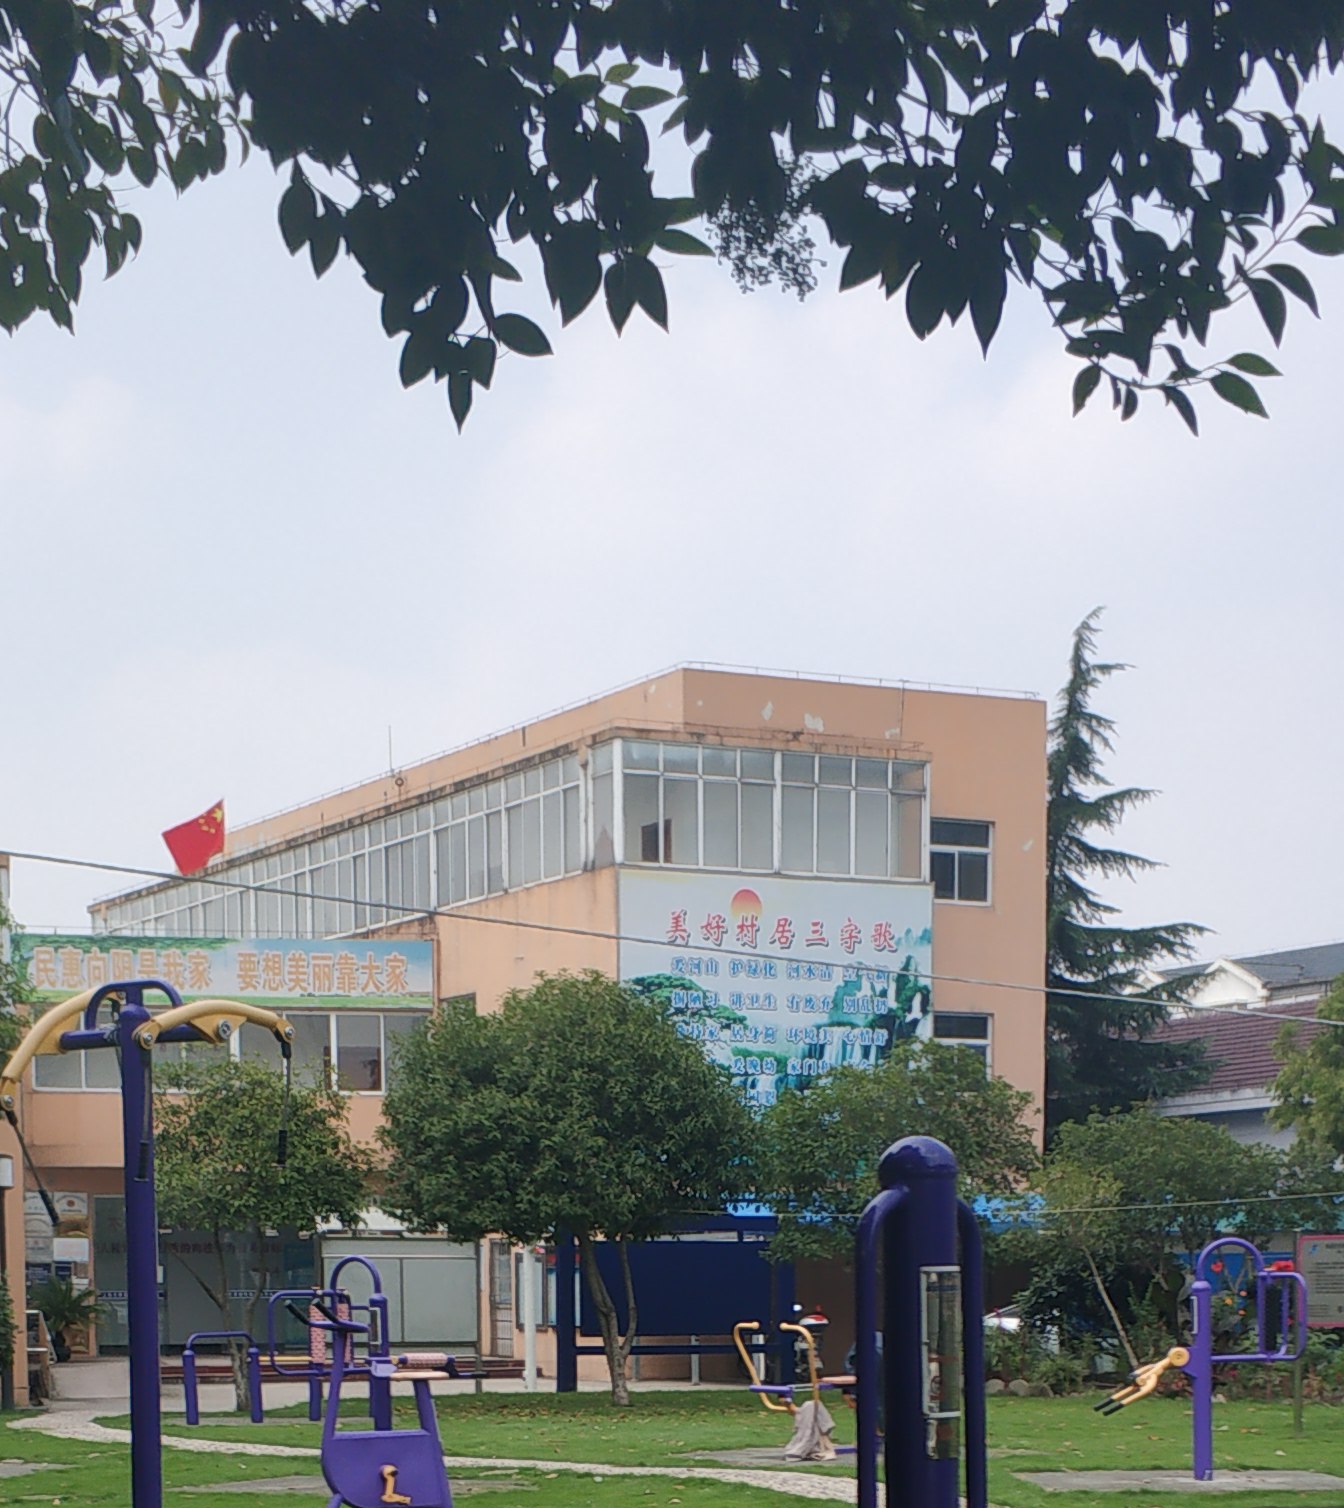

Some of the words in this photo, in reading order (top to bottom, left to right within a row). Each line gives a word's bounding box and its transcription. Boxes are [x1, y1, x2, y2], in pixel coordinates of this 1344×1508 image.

[666, 909, 897, 954] 美好村居三字歌
[236, 951, 408, 993] 要想美丽靠大家
[729, 991, 777, 1010] 讲卫生
